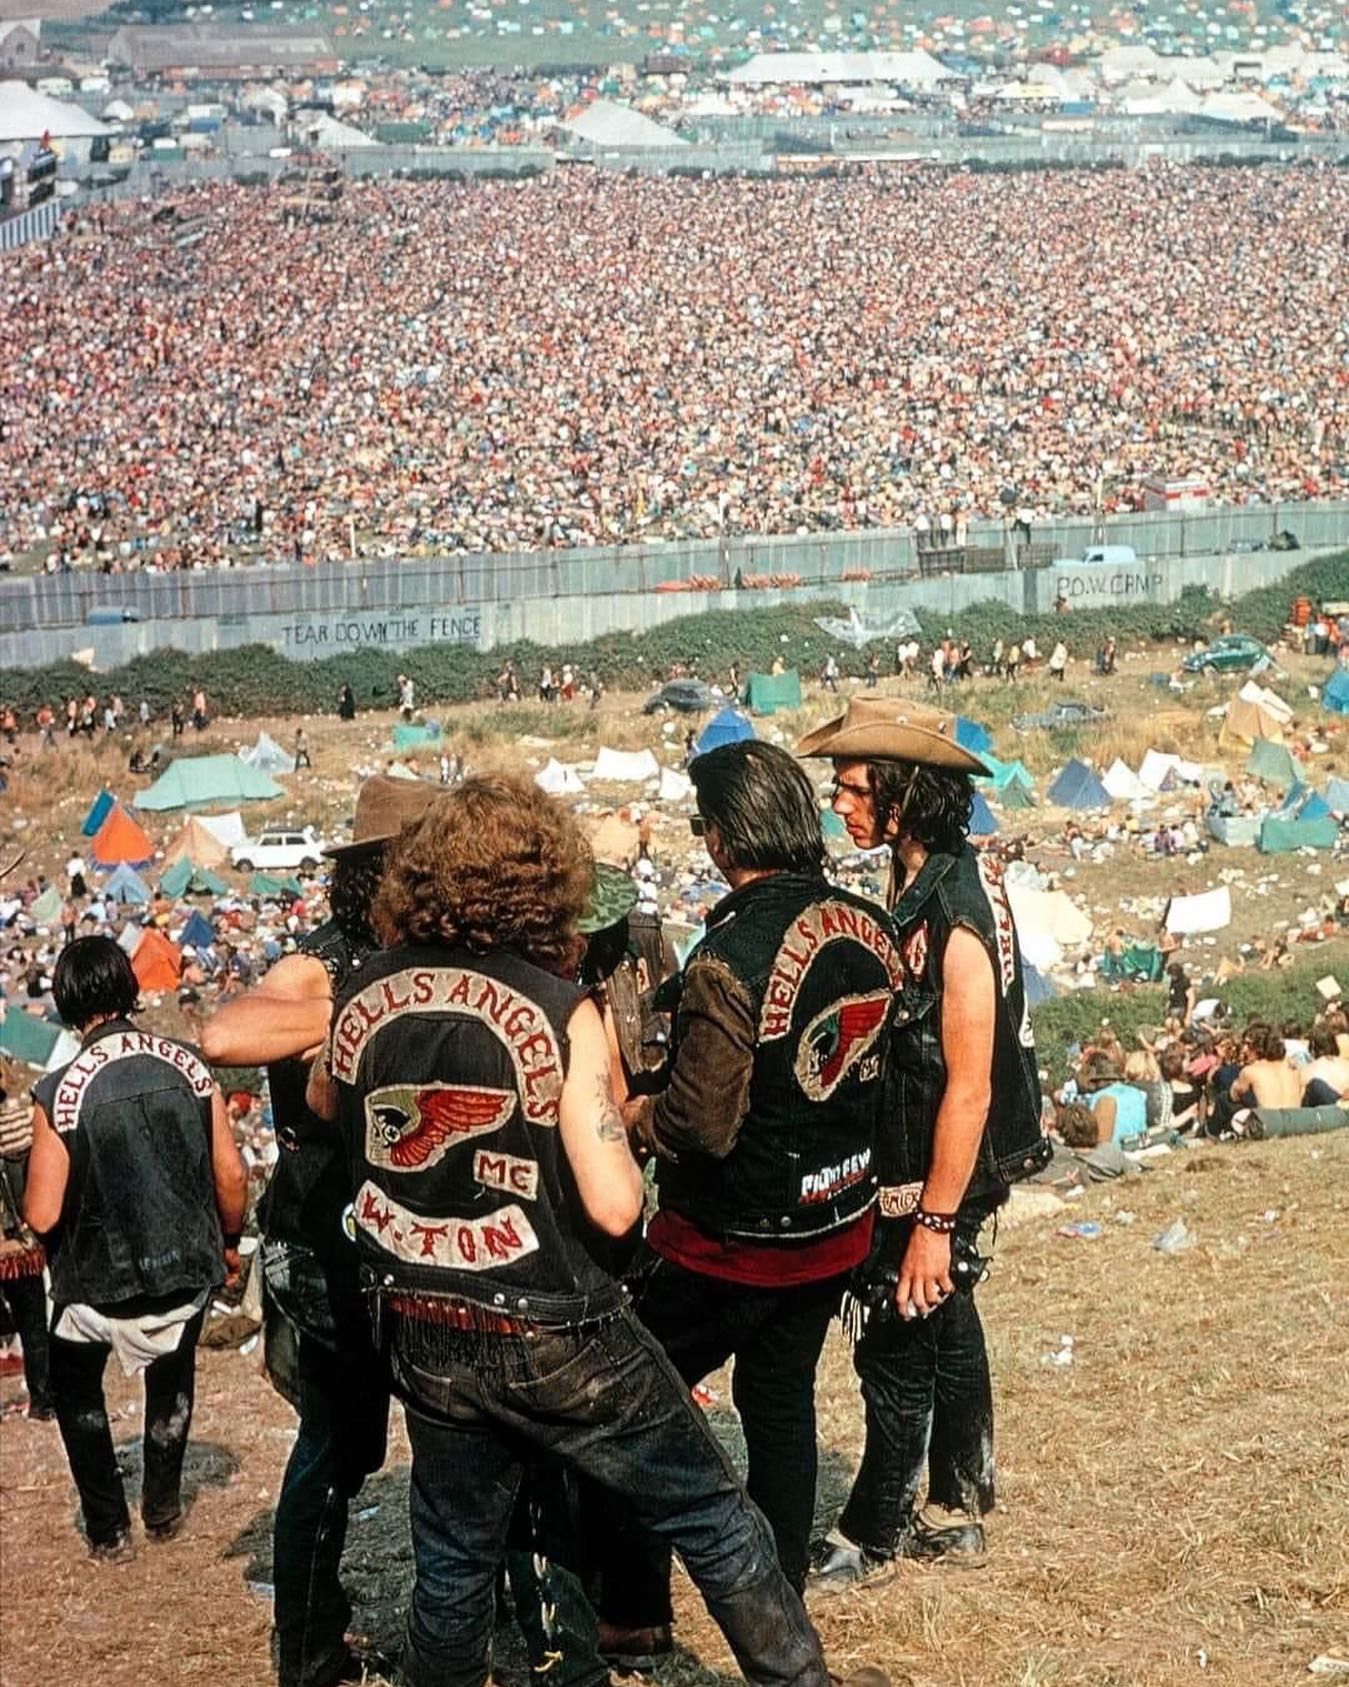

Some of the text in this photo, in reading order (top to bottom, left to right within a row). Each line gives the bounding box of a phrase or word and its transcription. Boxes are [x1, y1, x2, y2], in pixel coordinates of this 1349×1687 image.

[1110, 573, 1164, 595] CAMP
[281, 616, 480, 645] TEAR DOWN THE FENCE
[763, 920, 818, 1035] HELLS
[58, 1034, 213, 1127] HELLS ANGELS
[336, 972, 560, 1119] HELLS ANGELS
[478, 1155, 532, 1191] MC
[361, 1191, 523, 1263] W.TON
